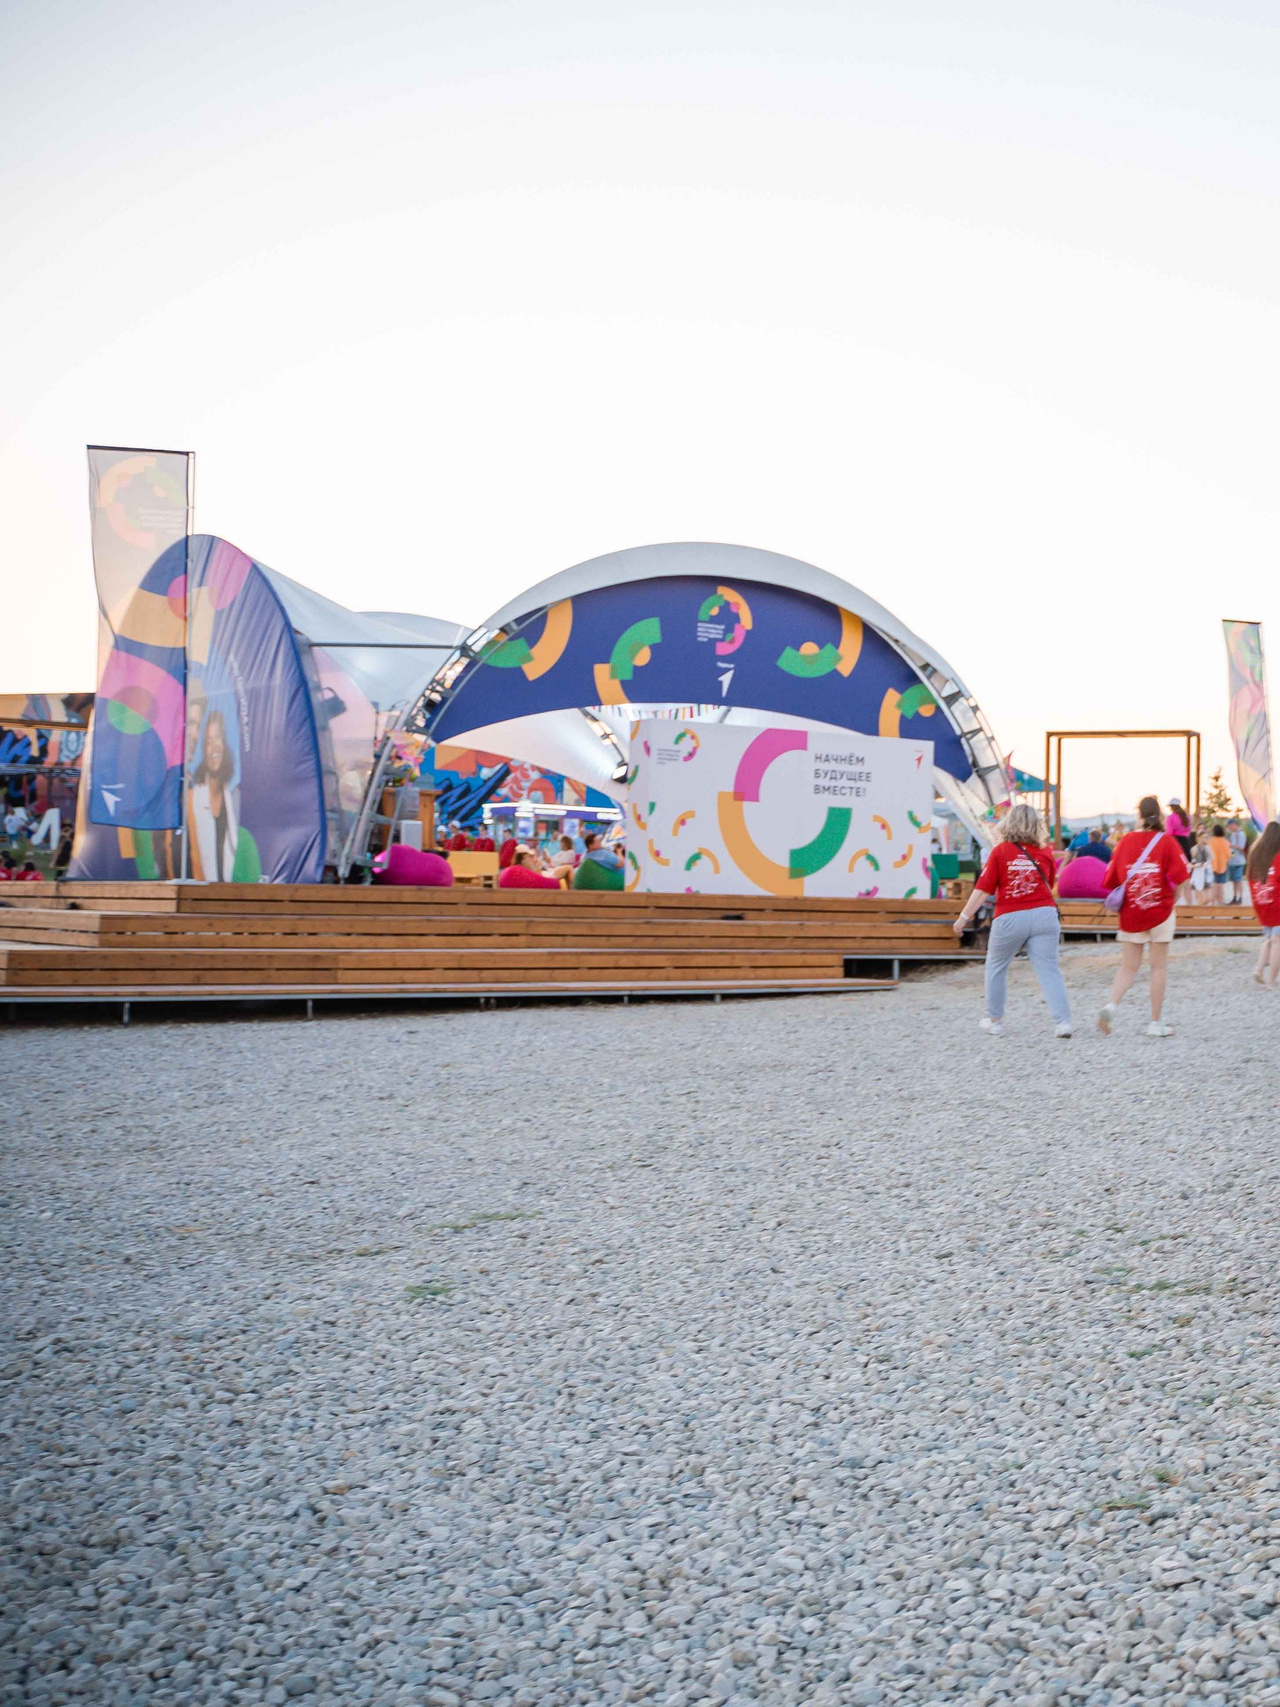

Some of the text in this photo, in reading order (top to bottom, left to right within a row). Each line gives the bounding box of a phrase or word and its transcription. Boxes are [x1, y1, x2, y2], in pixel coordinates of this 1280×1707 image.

[814, 753, 865, 766] НАЧНЁМ
[814, 769, 872, 782] БУДУЩЕЕ
[813, 784, 866, 797] ВМЕСТЕ!
